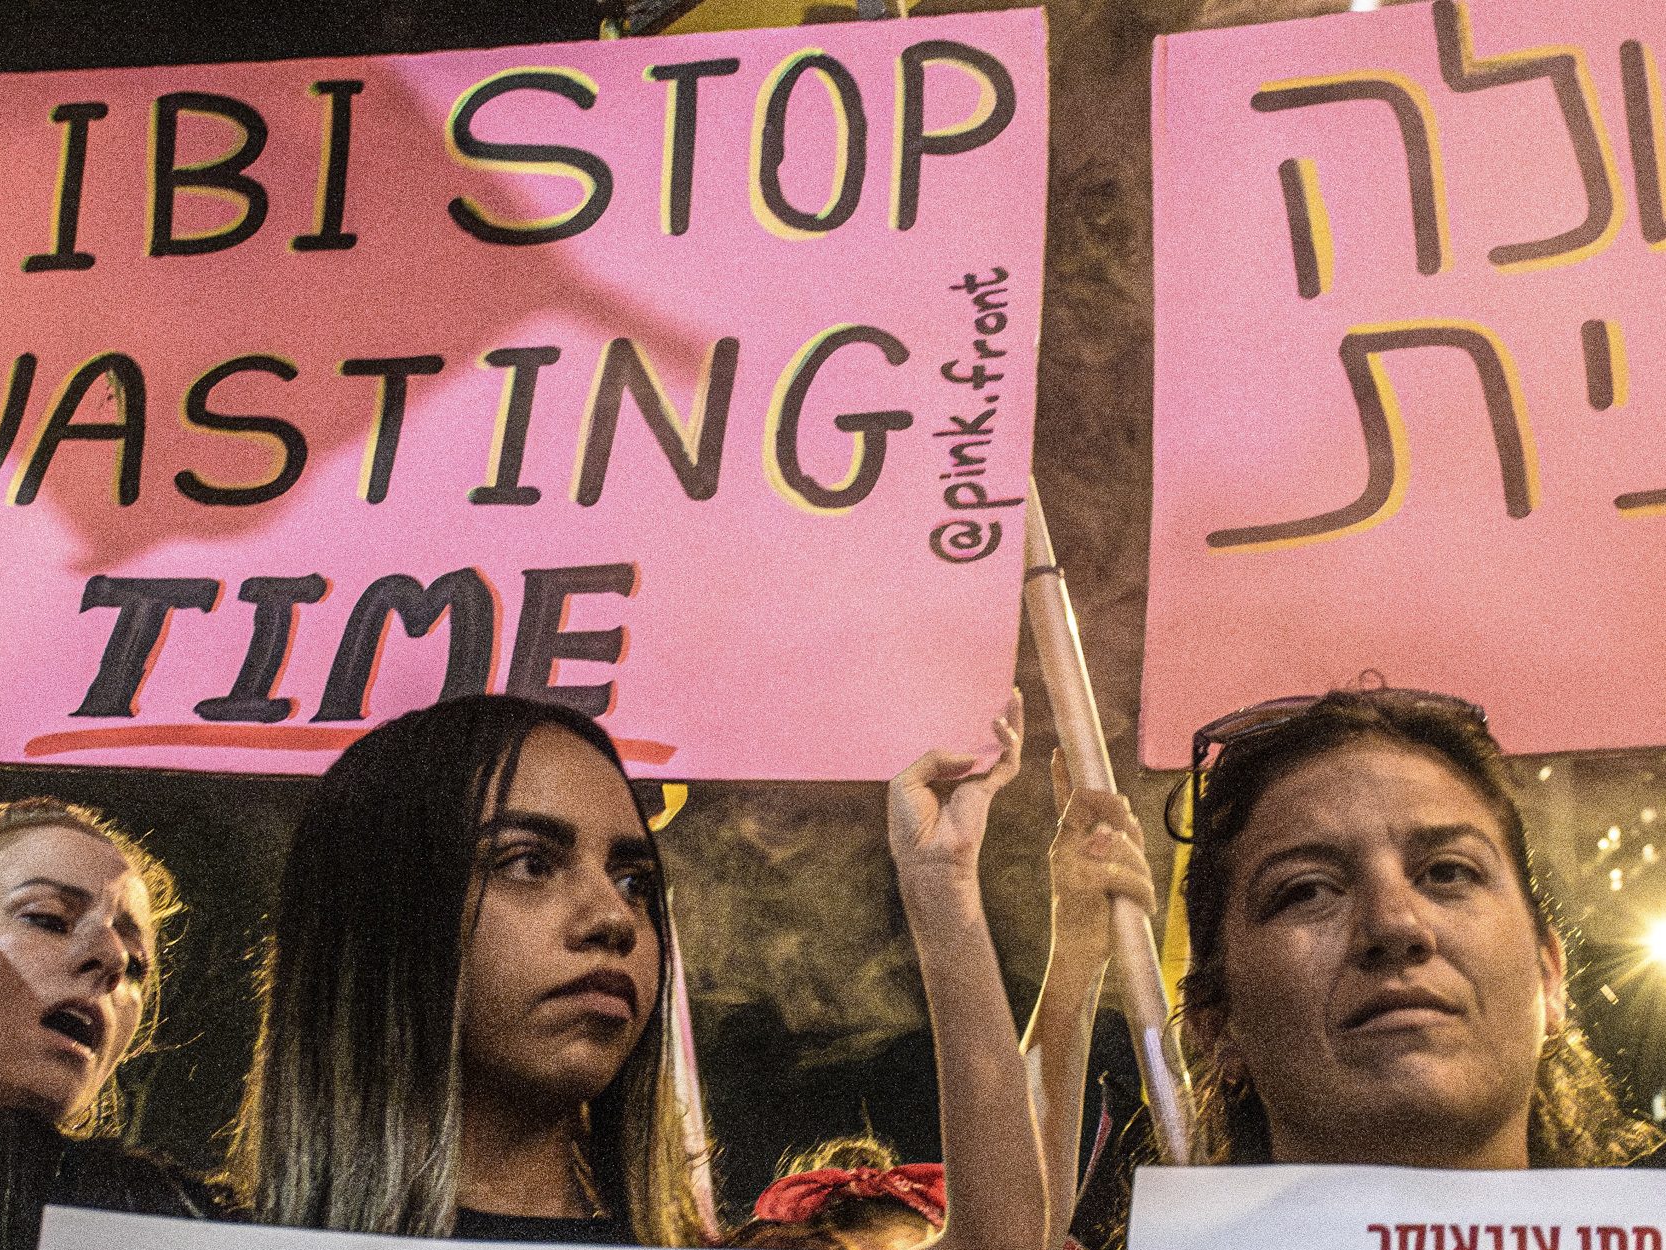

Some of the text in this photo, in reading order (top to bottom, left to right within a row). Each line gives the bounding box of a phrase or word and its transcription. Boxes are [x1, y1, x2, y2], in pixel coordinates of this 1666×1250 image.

[447, 40, 1017, 246] STOP
[929, 266, 1025, 564] @pink.front
[69, 561, 640, 724] TIME
